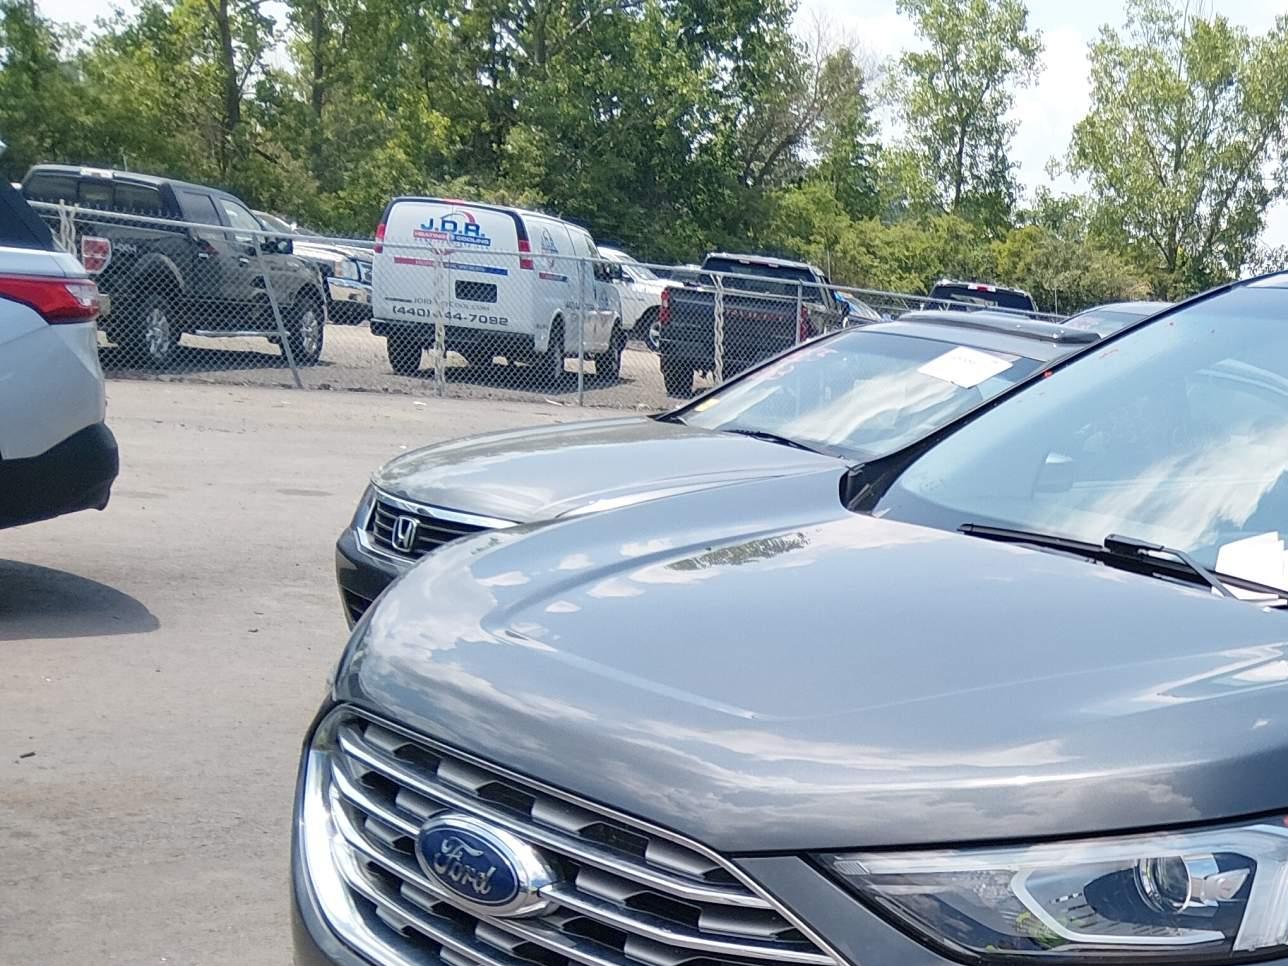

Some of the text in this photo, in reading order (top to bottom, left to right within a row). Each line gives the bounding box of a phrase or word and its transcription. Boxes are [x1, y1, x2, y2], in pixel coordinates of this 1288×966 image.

[420, 217, 486, 237] J.D.R.
[456, 236, 490, 245] COOLING
[433, 835, 497, 896] Ford
